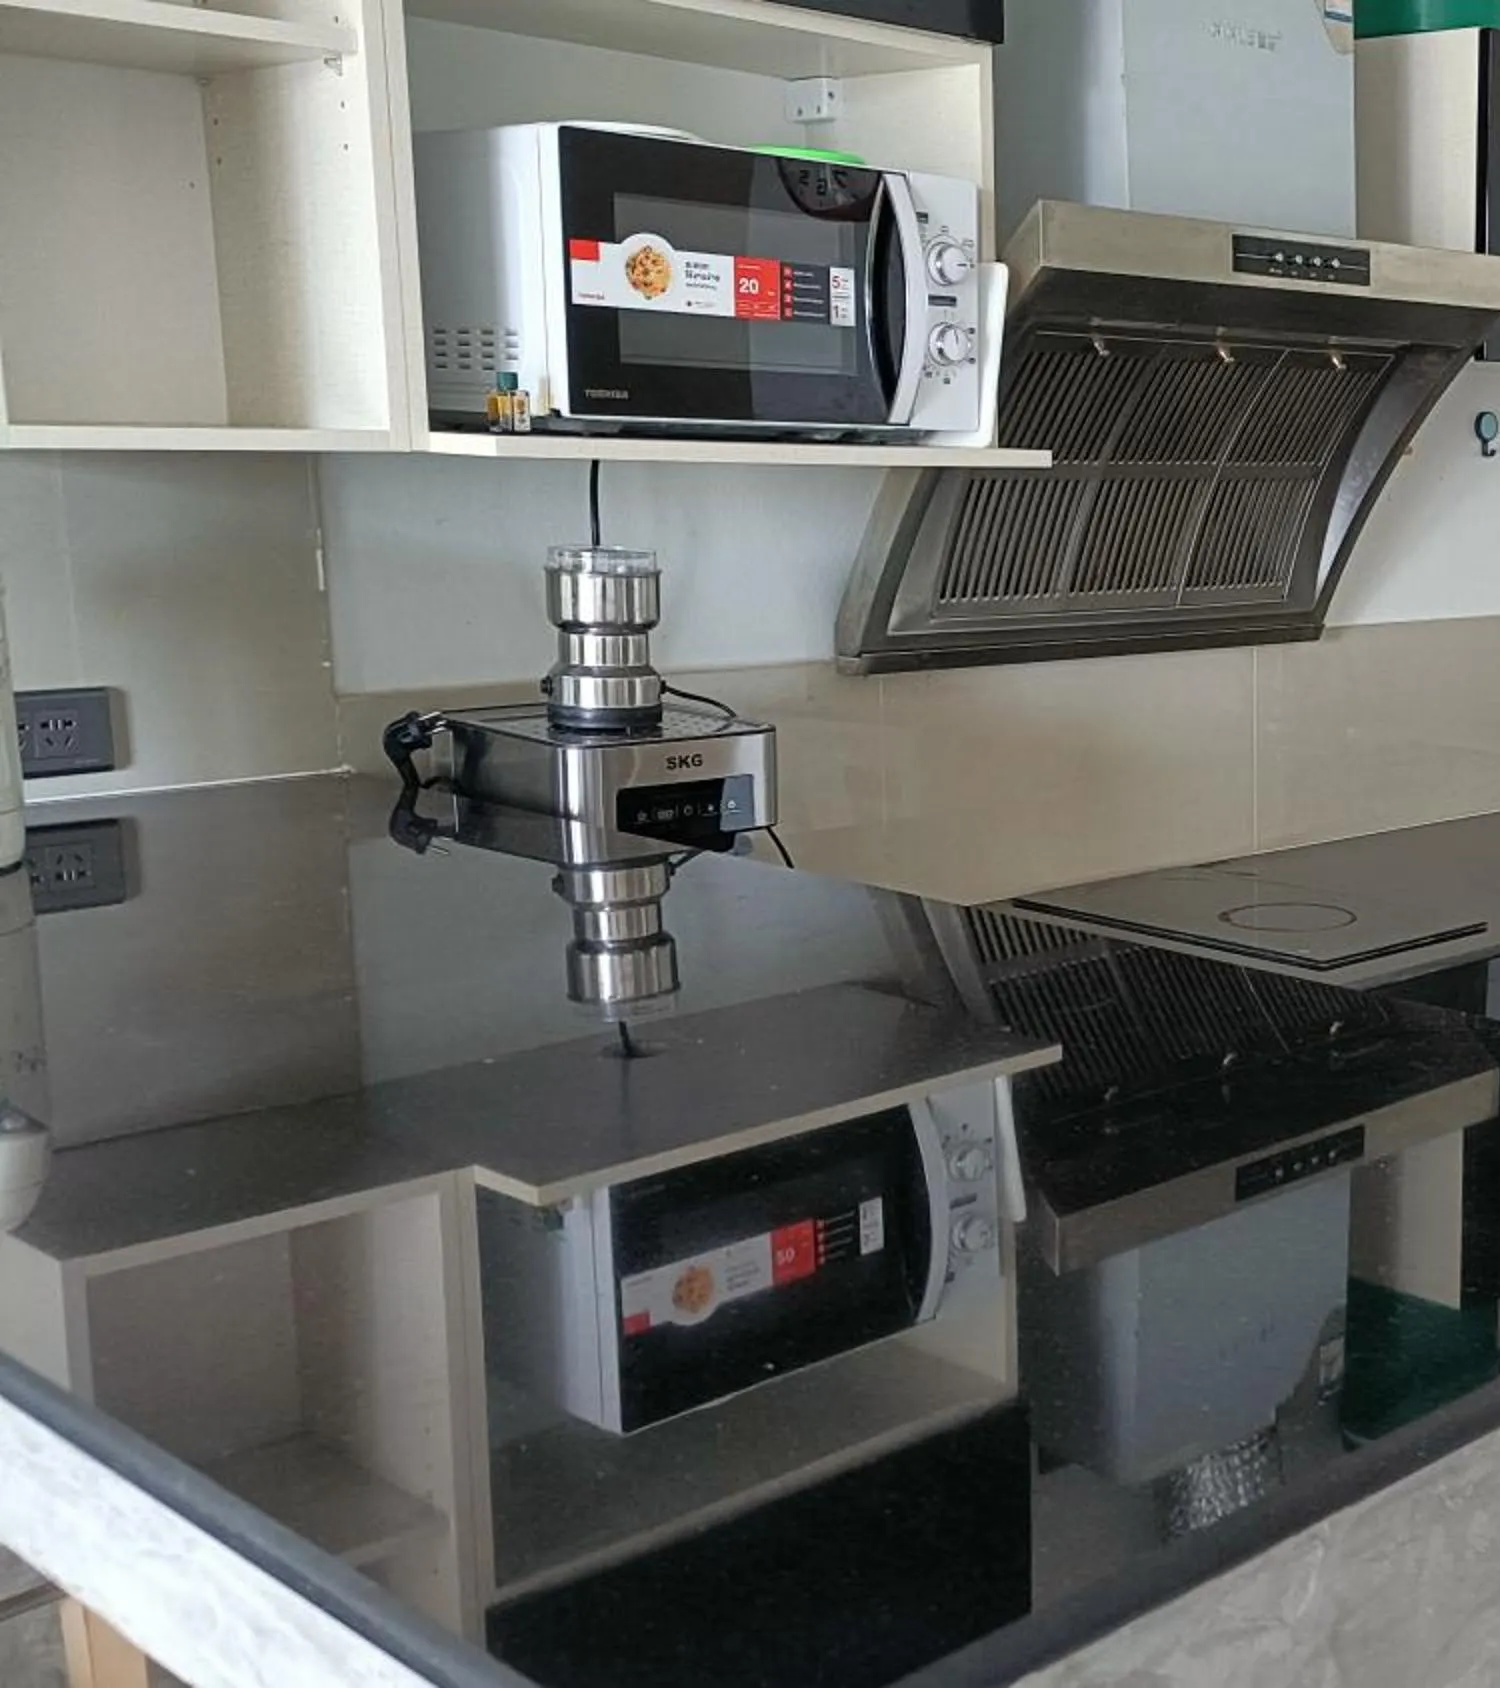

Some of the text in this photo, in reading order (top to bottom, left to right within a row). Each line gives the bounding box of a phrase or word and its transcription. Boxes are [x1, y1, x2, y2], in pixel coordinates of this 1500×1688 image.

[738, 277, 759, 295] 20
[831, 275, 841, 289] 5
[665, 753, 703, 770] SKG
